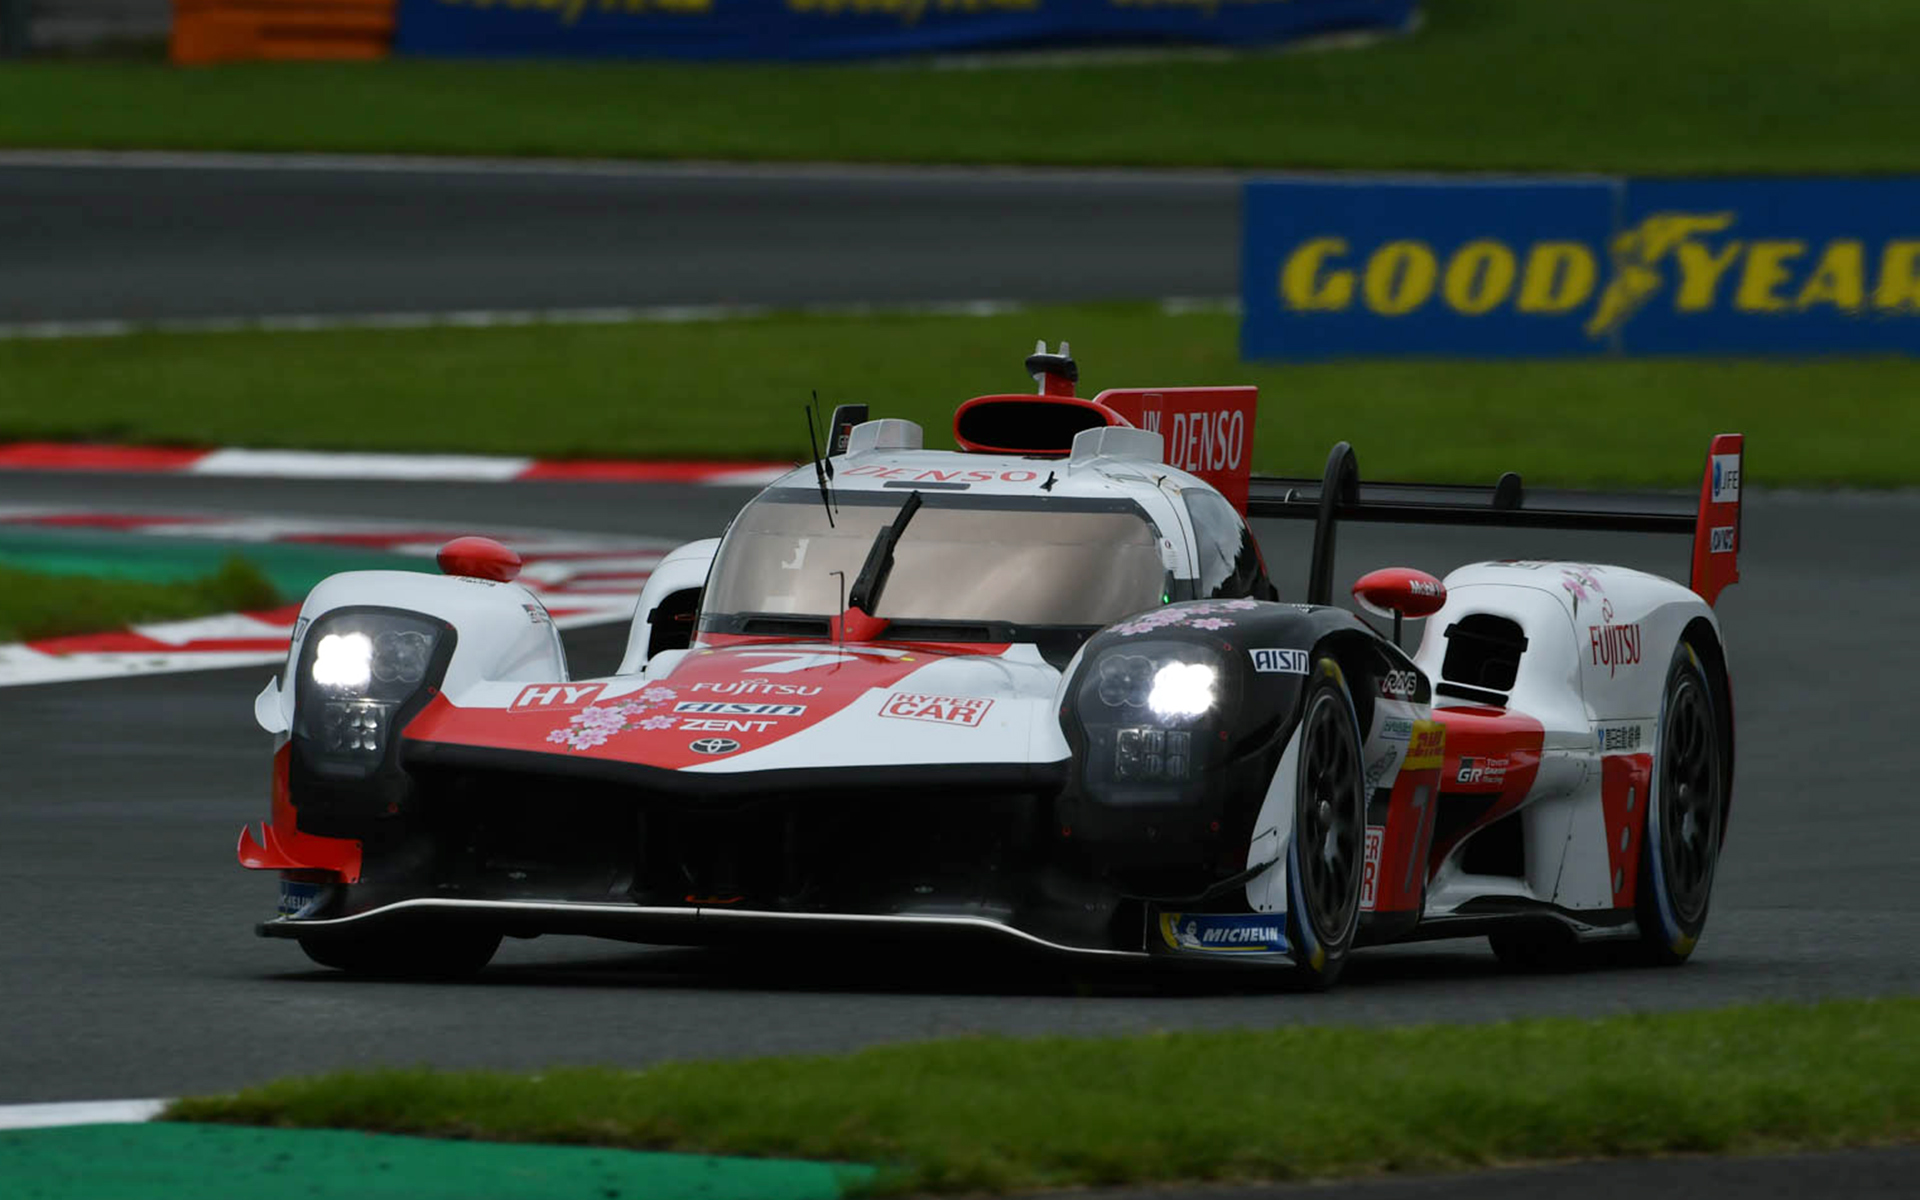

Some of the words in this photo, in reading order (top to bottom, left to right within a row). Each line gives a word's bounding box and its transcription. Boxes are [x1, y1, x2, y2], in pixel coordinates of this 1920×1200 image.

[1170, 409, 1245, 472] DENSO
[841, 464, 1039, 484] DENSO
[1721, 470, 1739, 490] JFE
[1255, 650, 1310, 673] AISIN
[1588, 624, 1642, 679] FUJITSU
[734, 652, 860, 674] 7
[690, 680, 823, 697] FUJITSU
[1381, 669, 1418, 696] RAYS
[516, 685, 594, 707] HY
[892, 692, 984, 709] HYPER
[677, 702, 804, 717] AISIN
[889, 703, 976, 724] CAR
[678, 718, 778, 733] ZENT
[1457, 767, 1483, 783] GR
[1202, 926, 1279, 943] MICHELIN
